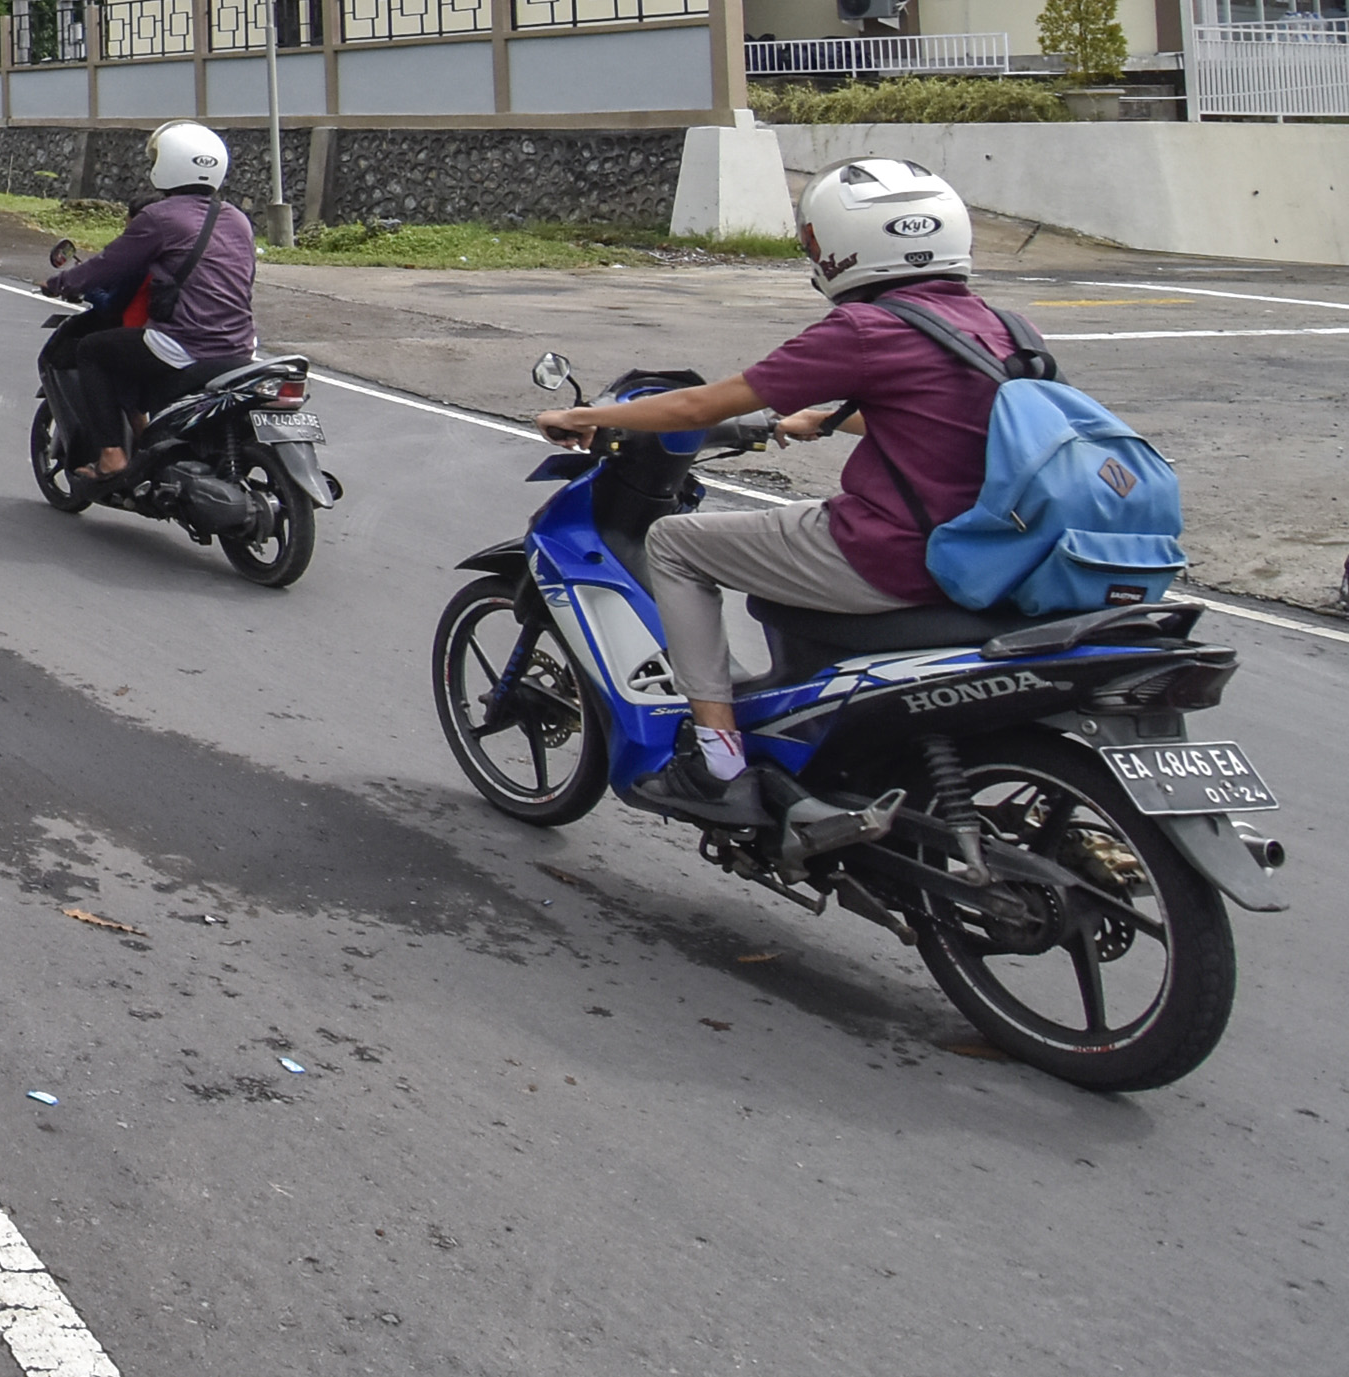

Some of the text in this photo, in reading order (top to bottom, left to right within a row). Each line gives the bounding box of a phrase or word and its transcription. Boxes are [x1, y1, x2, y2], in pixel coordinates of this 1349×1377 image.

[908, 253, 930, 261] DOT
[901, 671, 1048, 714] HONDA
[1112, 749, 1249, 779] EA 4846 EA
